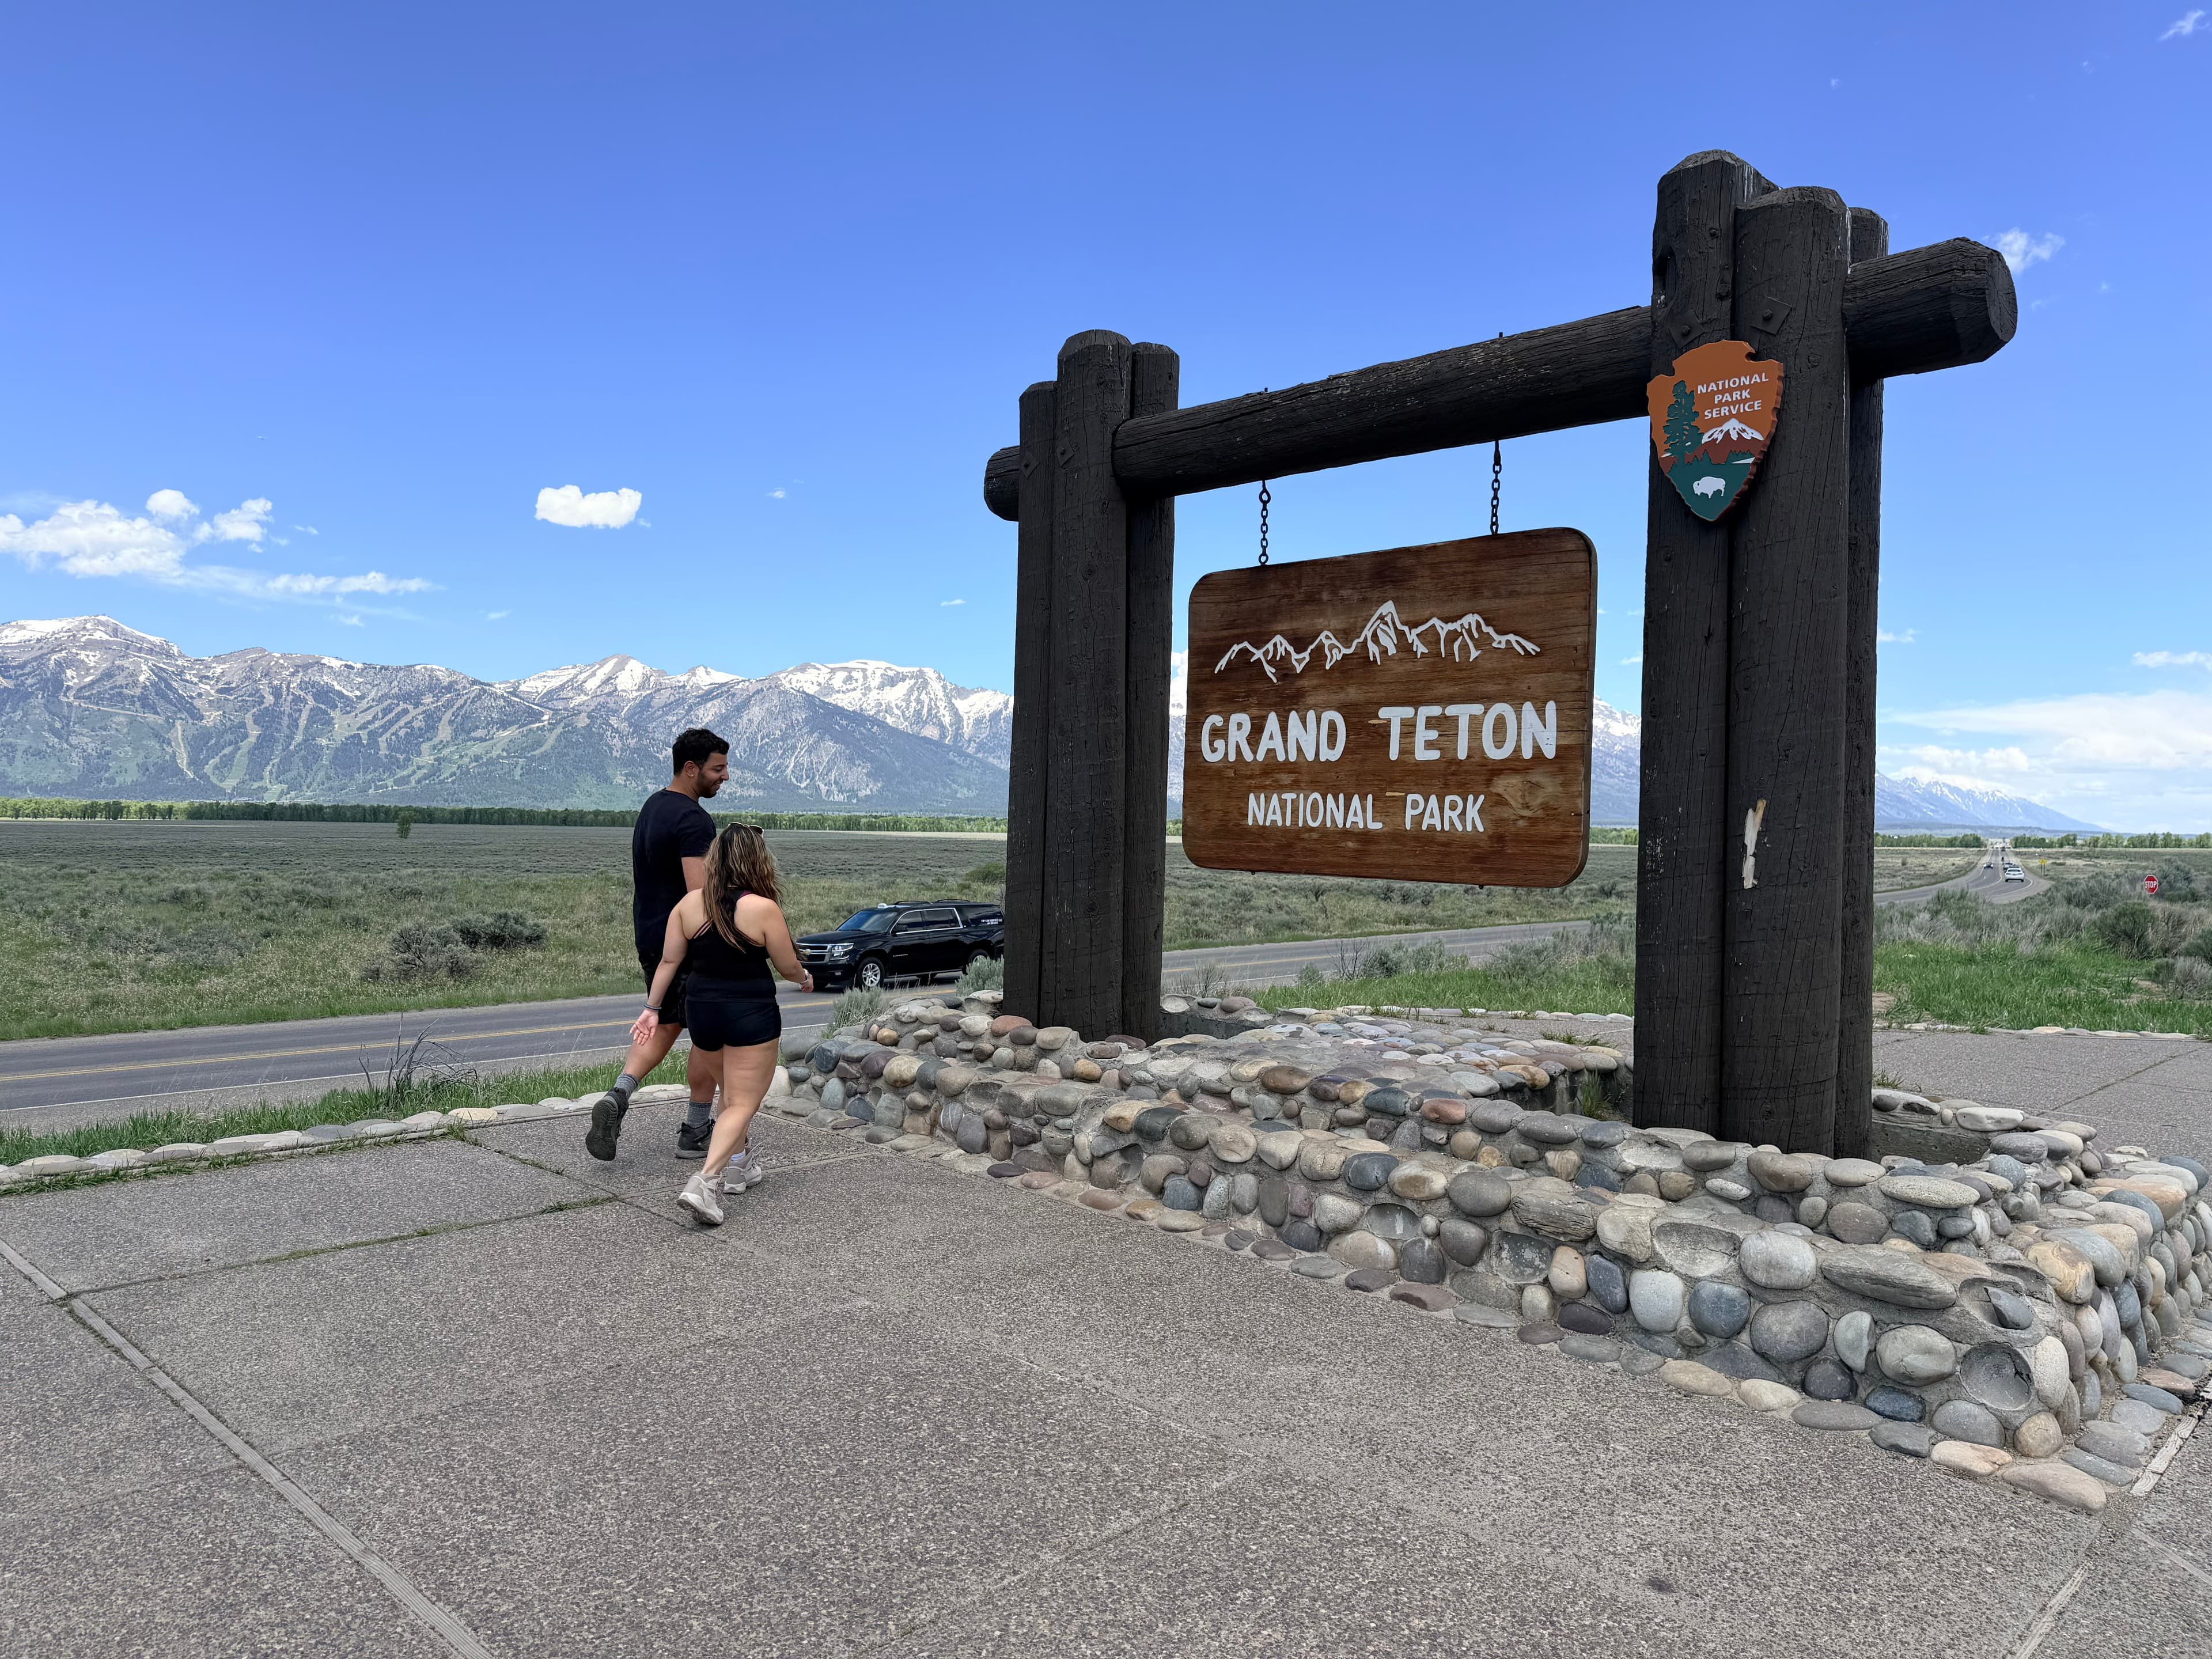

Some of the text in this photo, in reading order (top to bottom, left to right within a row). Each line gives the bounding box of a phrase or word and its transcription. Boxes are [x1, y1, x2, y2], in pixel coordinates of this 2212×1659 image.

[1697, 372, 1769, 394] NATIONAL
[1714, 388, 1751, 404] PARK
[1704, 400, 1762, 419] SERVICE
[1201, 700, 1556, 763] GRAND TETON
[1247, 791, 1485, 833] NATIONAL PARK
